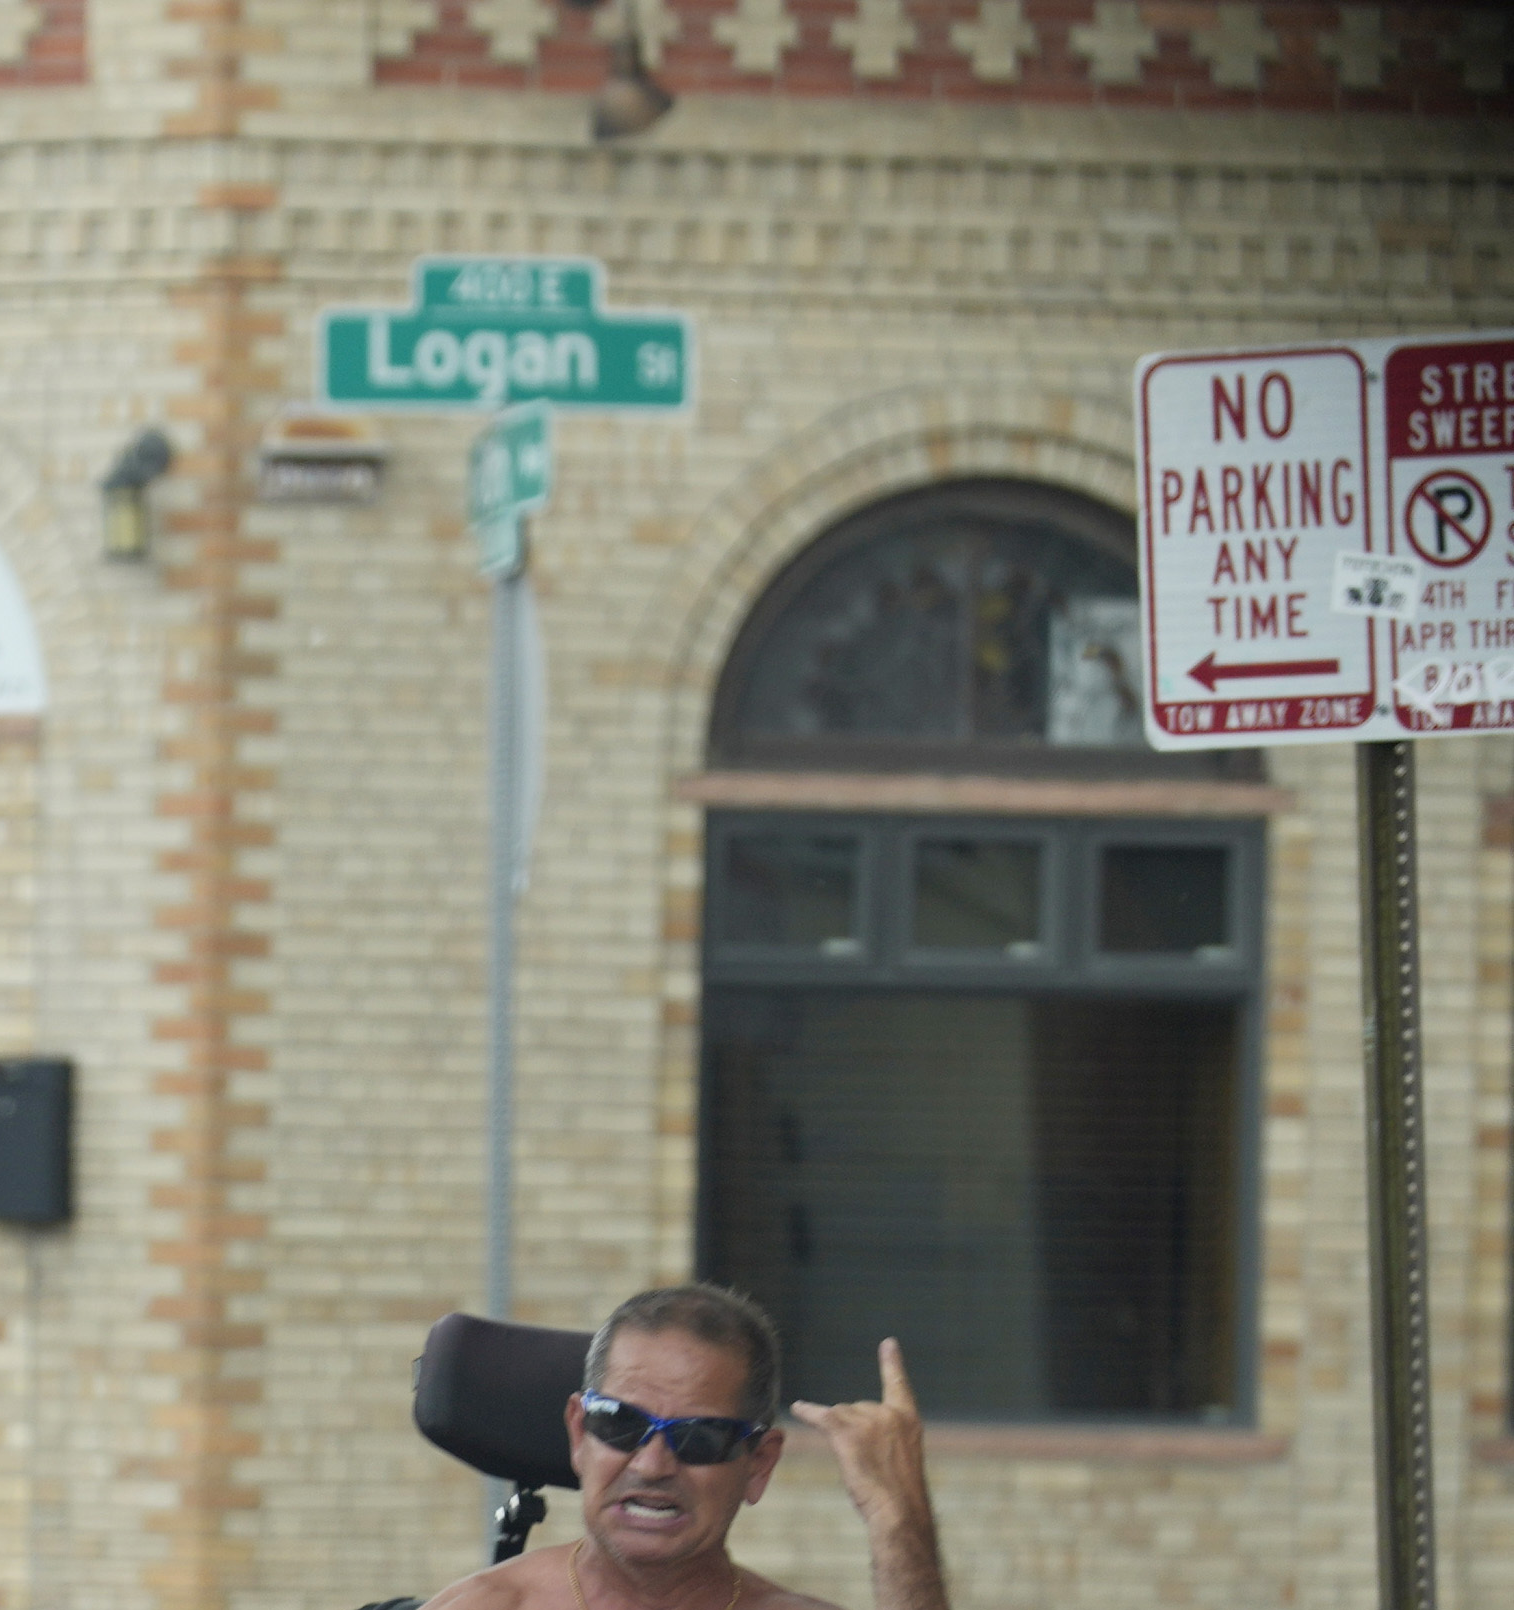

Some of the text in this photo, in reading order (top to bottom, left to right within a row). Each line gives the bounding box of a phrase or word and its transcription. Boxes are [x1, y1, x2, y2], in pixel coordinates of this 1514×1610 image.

[366, 318, 600, 406] Logan
[1211, 371, 1293, 442] NO
[1161, 459, 1354, 535] PARKING
[1212, 536, 1299, 585] ANY
[1207, 593, 1310, 640] TIME
[1399, 619, 1457, 652] APR
[1163, 696, 1363, 732] TOW AWAY ZONE
